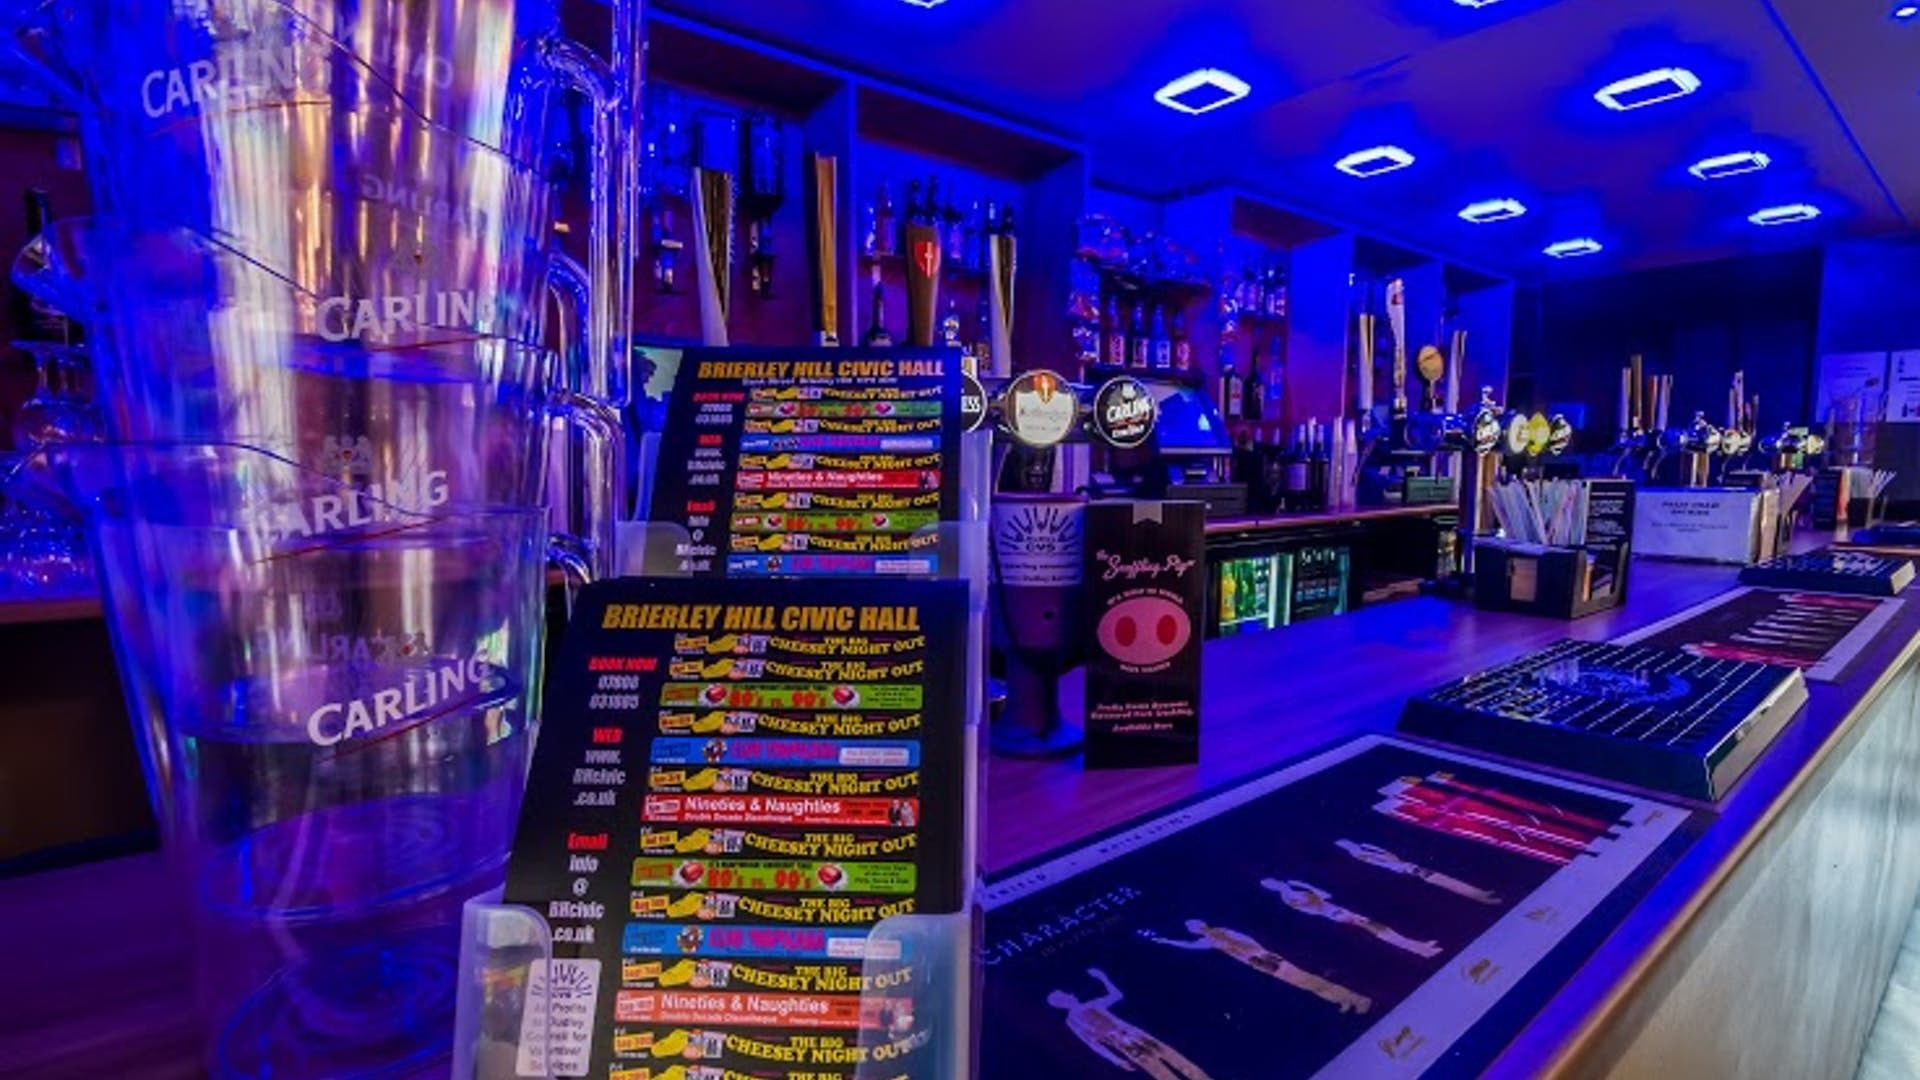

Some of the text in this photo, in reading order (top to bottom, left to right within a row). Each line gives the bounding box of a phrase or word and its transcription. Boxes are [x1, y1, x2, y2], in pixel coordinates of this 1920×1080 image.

[698, 360, 944, 378] BRIERLEY HILL CIVIC HALL
[814, 472, 824, 482] &
[602, 604, 920, 631] BRIERLEY HILL CIVIC HALL
[770, 635, 926, 655] CHEESEY NIGHT OUT
[766, 660, 924, 680] CHEESEY NIGHT OUT
[307, 654, 491, 747] CARLING
[758, 713, 920, 735] CHEESEY NIGHT OUT
[752, 771, 919, 795] CHEESEY NIGHT OUT
[685, 797, 840, 815] Nineties & Naughties
[568, 832, 609, 849] Email
[745, 833, 918, 856] CHEESEY NIGHT OUT
[805, 833, 830, 842] THE
[738, 896, 918, 923] CHEESEY NIGHT OUT
[800, 898, 826, 907] THE
[731, 964, 912, 990] CHEESEY NIGHT OUT
[794, 966, 847, 975] THE BIG
[661, 994, 829, 1016] Nineties & Naughties
[726, 1034, 912, 1064] CHEESEY NIGHT OUT
[790, 1037, 817, 1047] THE
